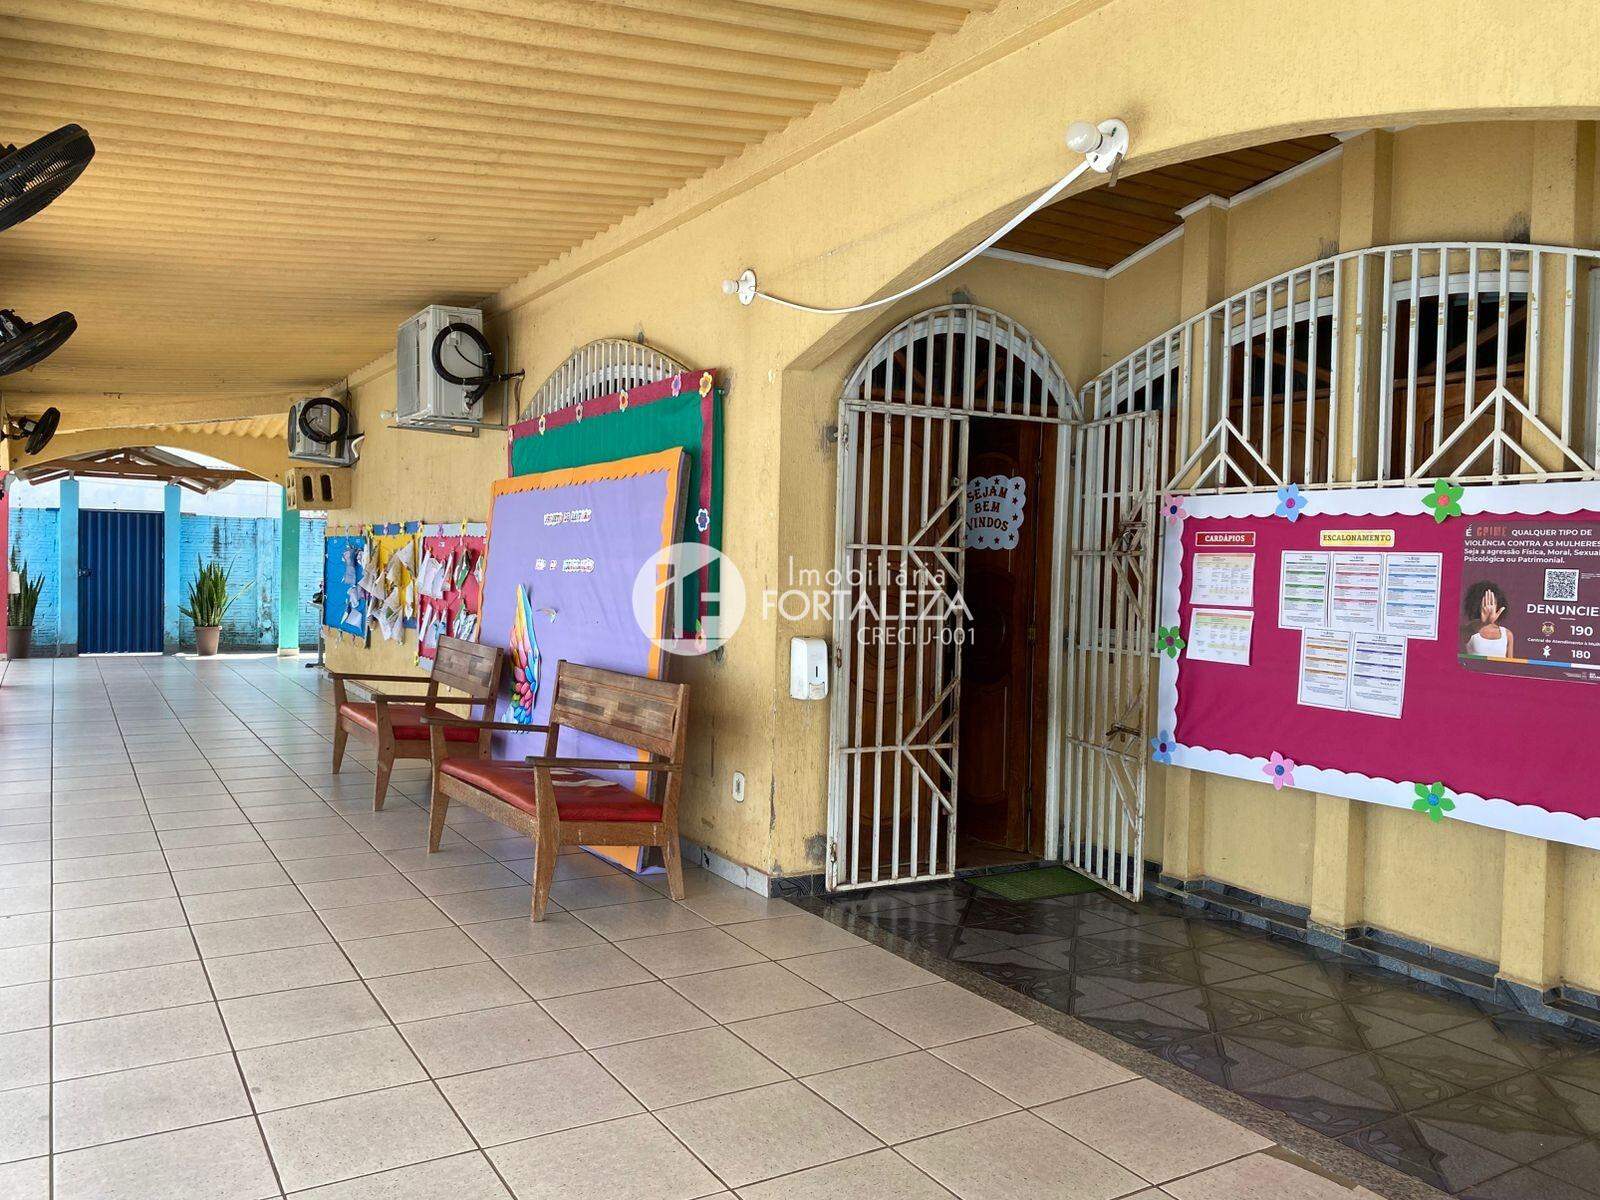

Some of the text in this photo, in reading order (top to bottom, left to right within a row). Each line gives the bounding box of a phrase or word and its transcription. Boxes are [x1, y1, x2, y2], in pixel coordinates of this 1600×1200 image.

[967, 486, 1008, 503] SEJAM
[974, 501, 1001, 513] BEM
[965, 517, 1009, 531] VINDOS
[1465, 523, 1473, 537] É
[1511, 529, 1557, 537] QUALQUER
[1204, 533, 1246, 542] CARDÁPIOS
[1322, 534, 1392, 542] ESCALONAMENTO
[1464, 538, 1506, 547] VIOLÊNCIA
[1555, 540, 1600, 548] MULHERES
[1463, 548, 1479, 556] Seja
[1517, 556, 1565, 564] Patrimonial.
[1526, 603, 1600, 617] DENUNCIE
[1570, 625, 1594, 637] 190
[1571, 649, 1591, 659] 180
